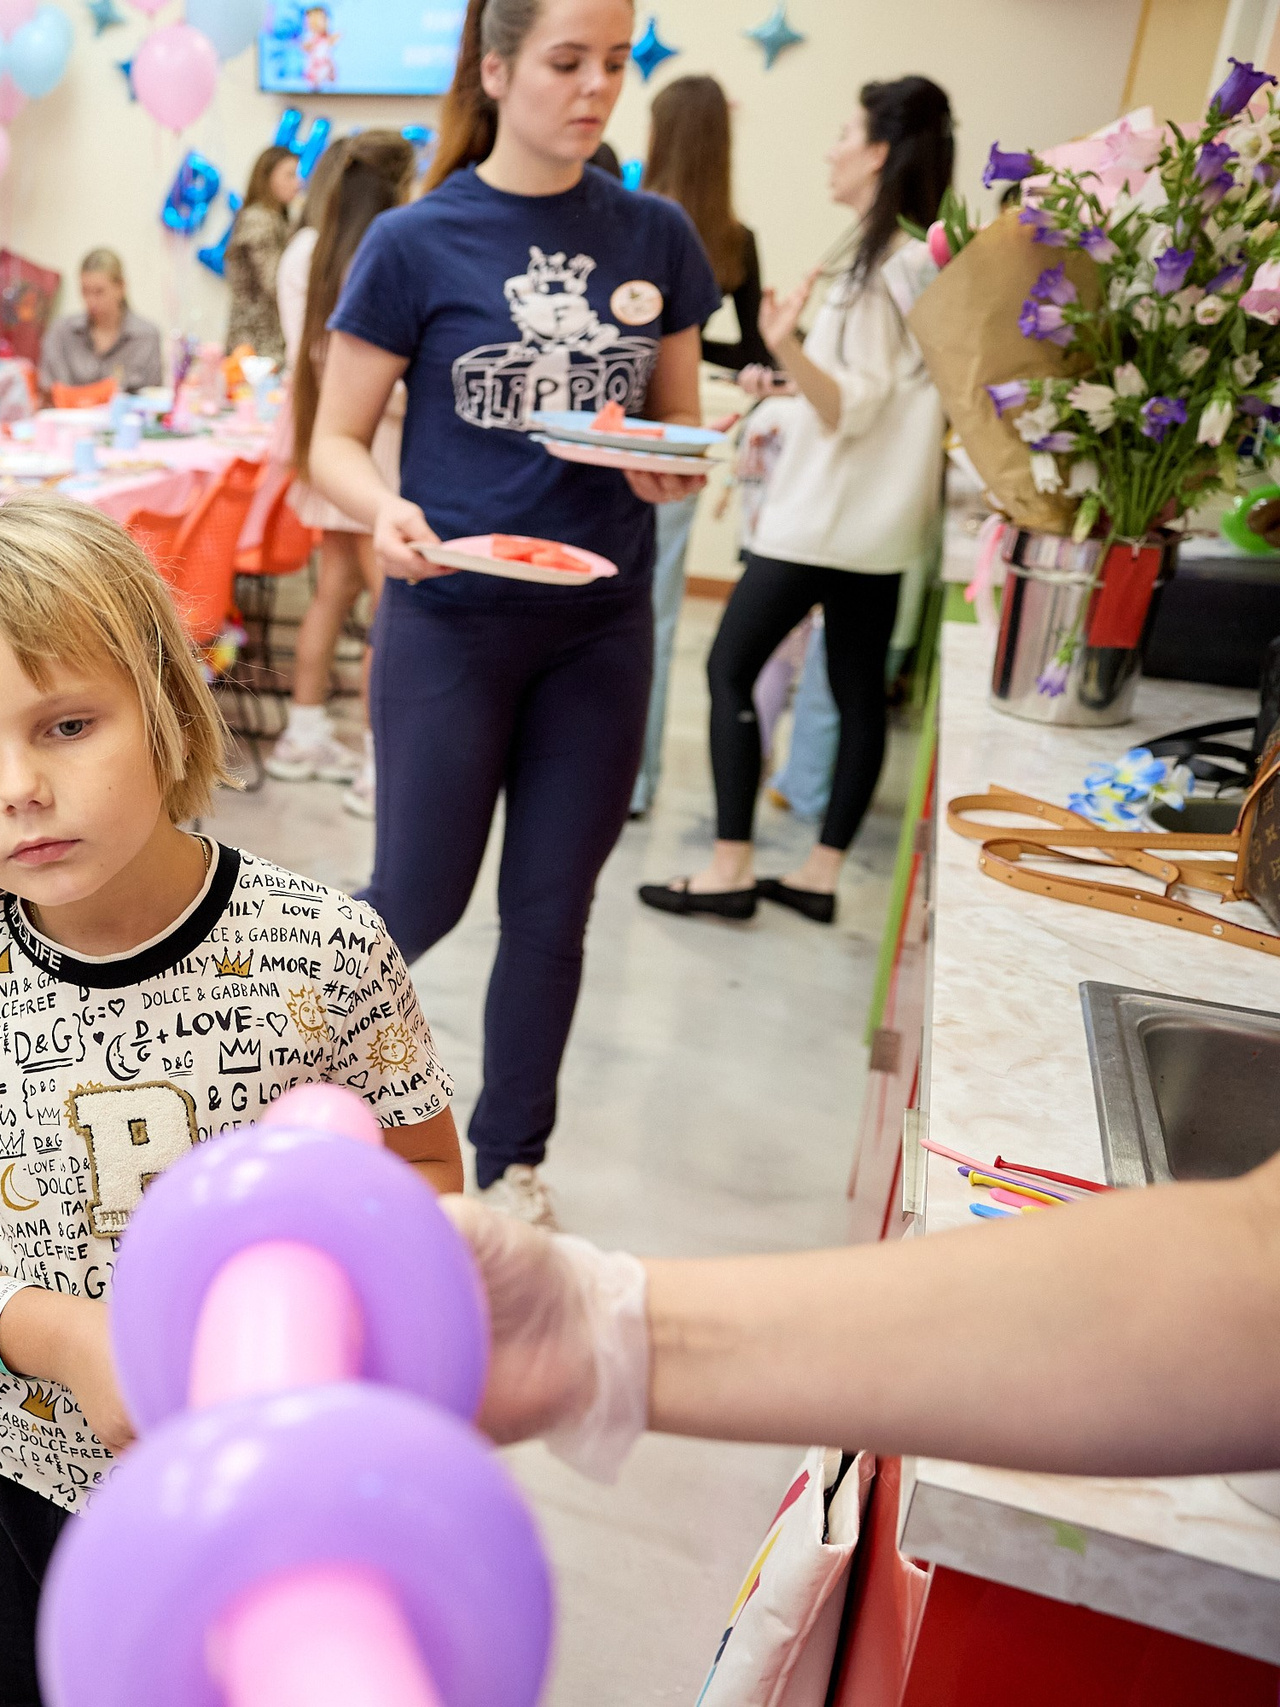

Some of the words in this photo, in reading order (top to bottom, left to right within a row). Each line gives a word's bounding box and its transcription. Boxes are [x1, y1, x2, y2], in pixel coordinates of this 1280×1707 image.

[281, 903, 320, 919] LOVE
[235, 929, 244, 944] &
[249, 927, 321, 948] GABBANA
[260, 954, 321, 980] AMORE
[23, 978, 32, 992] &
[142, 986, 191, 1009] DOLCE
[197, 987, 206, 1001] &
[211, 982, 280, 1000] GABBANA
[176, 1006, 252, 1038] LOVE
[338, 1001, 395, 1056] AMORE
[14, 1018, 72, 1065] D&G
[162, 1050, 194, 1072] D&G
[36, 1176, 87, 1196] DOLCE
[20, 1430, 114, 1459] DOLCEFREE
